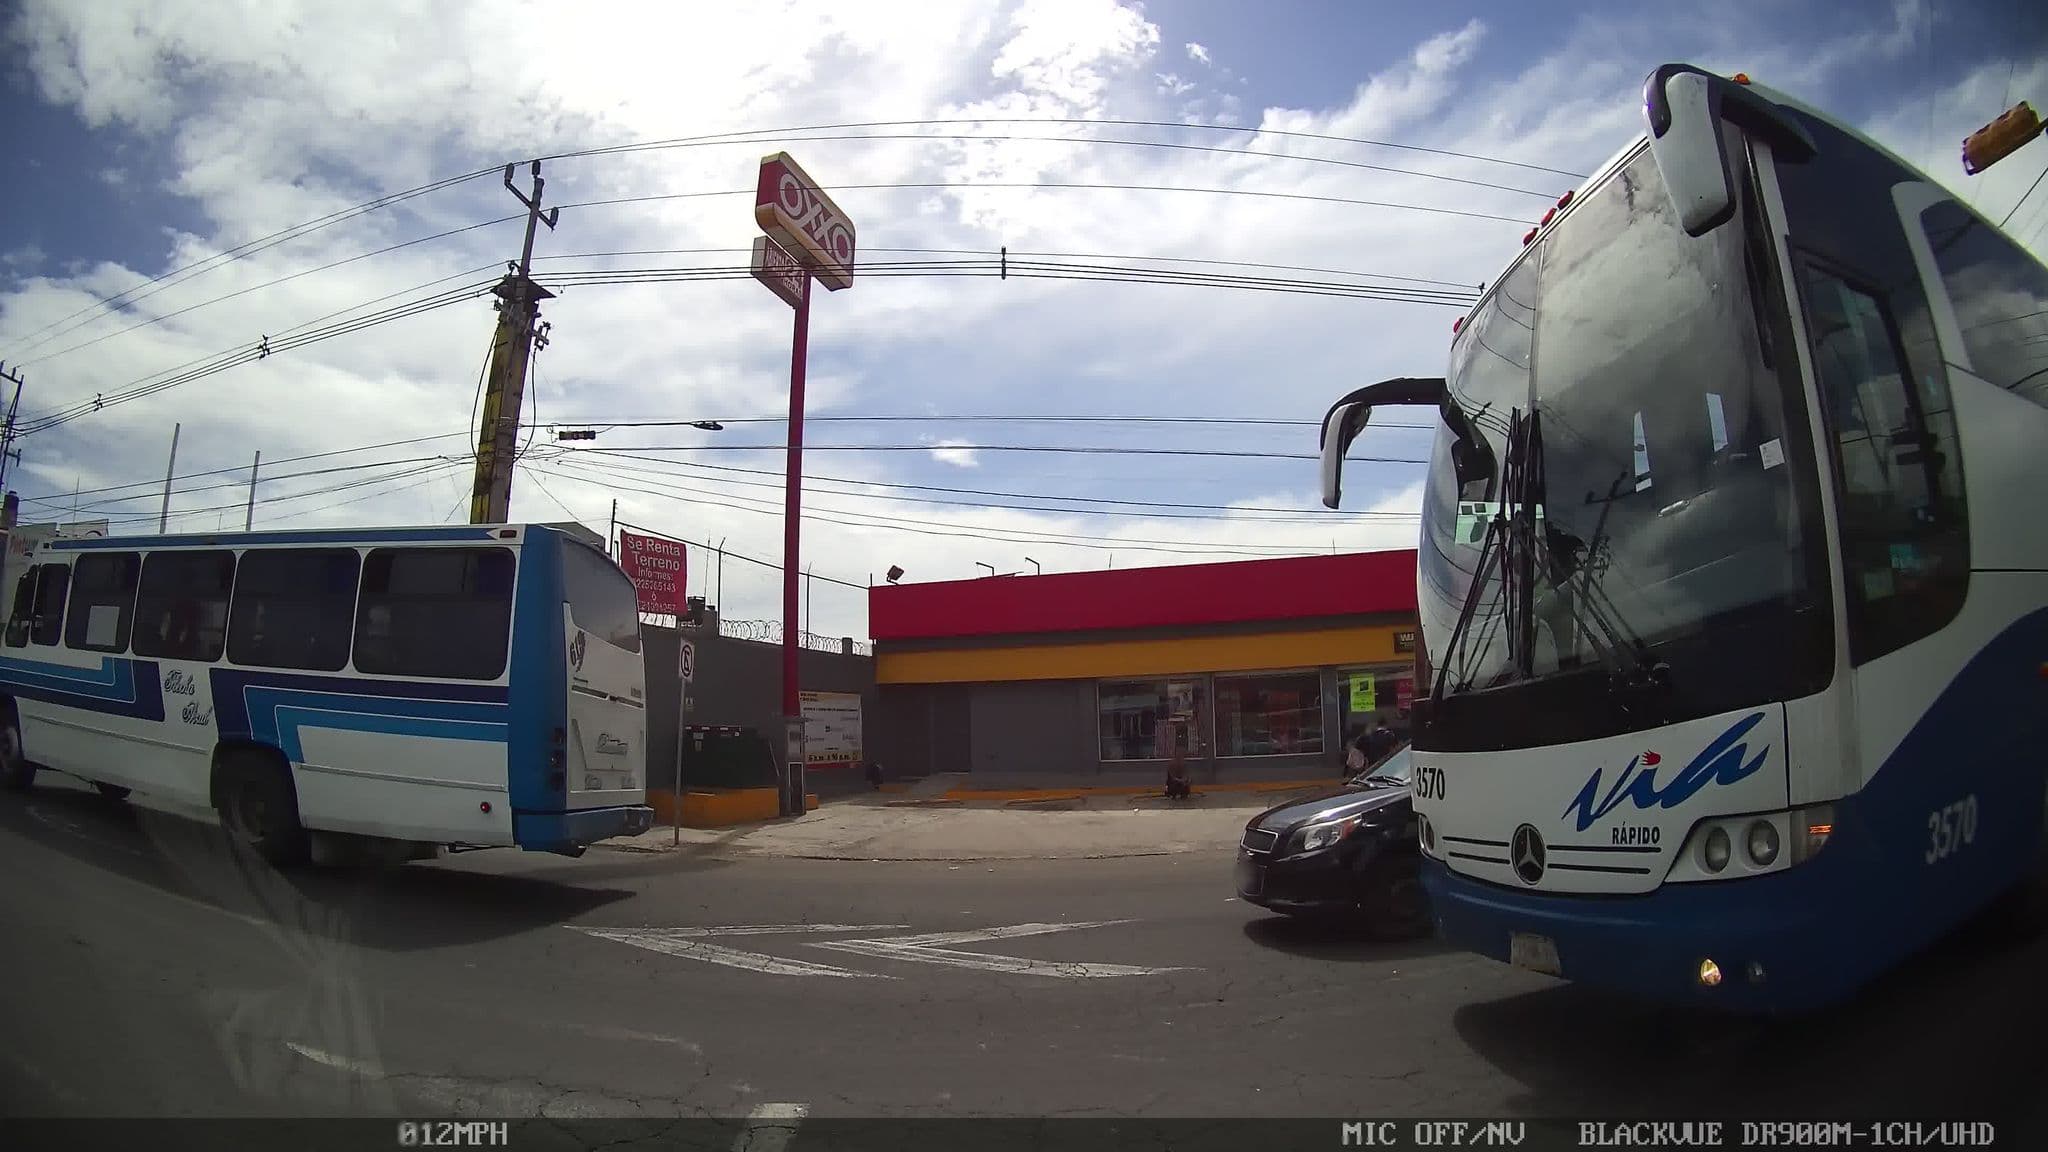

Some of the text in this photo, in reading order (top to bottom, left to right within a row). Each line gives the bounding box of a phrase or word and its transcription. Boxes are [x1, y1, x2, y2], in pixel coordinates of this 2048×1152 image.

[780, 173, 853, 265] OXXO
[627, 535, 680, 556] Se Renta
[632, 550, 680, 571] Terreno
[1416, 766, 1445, 801] 3570
[1612, 820, 1661, 845] RÁPIDO
[1925, 793, 1978, 865] 3570
